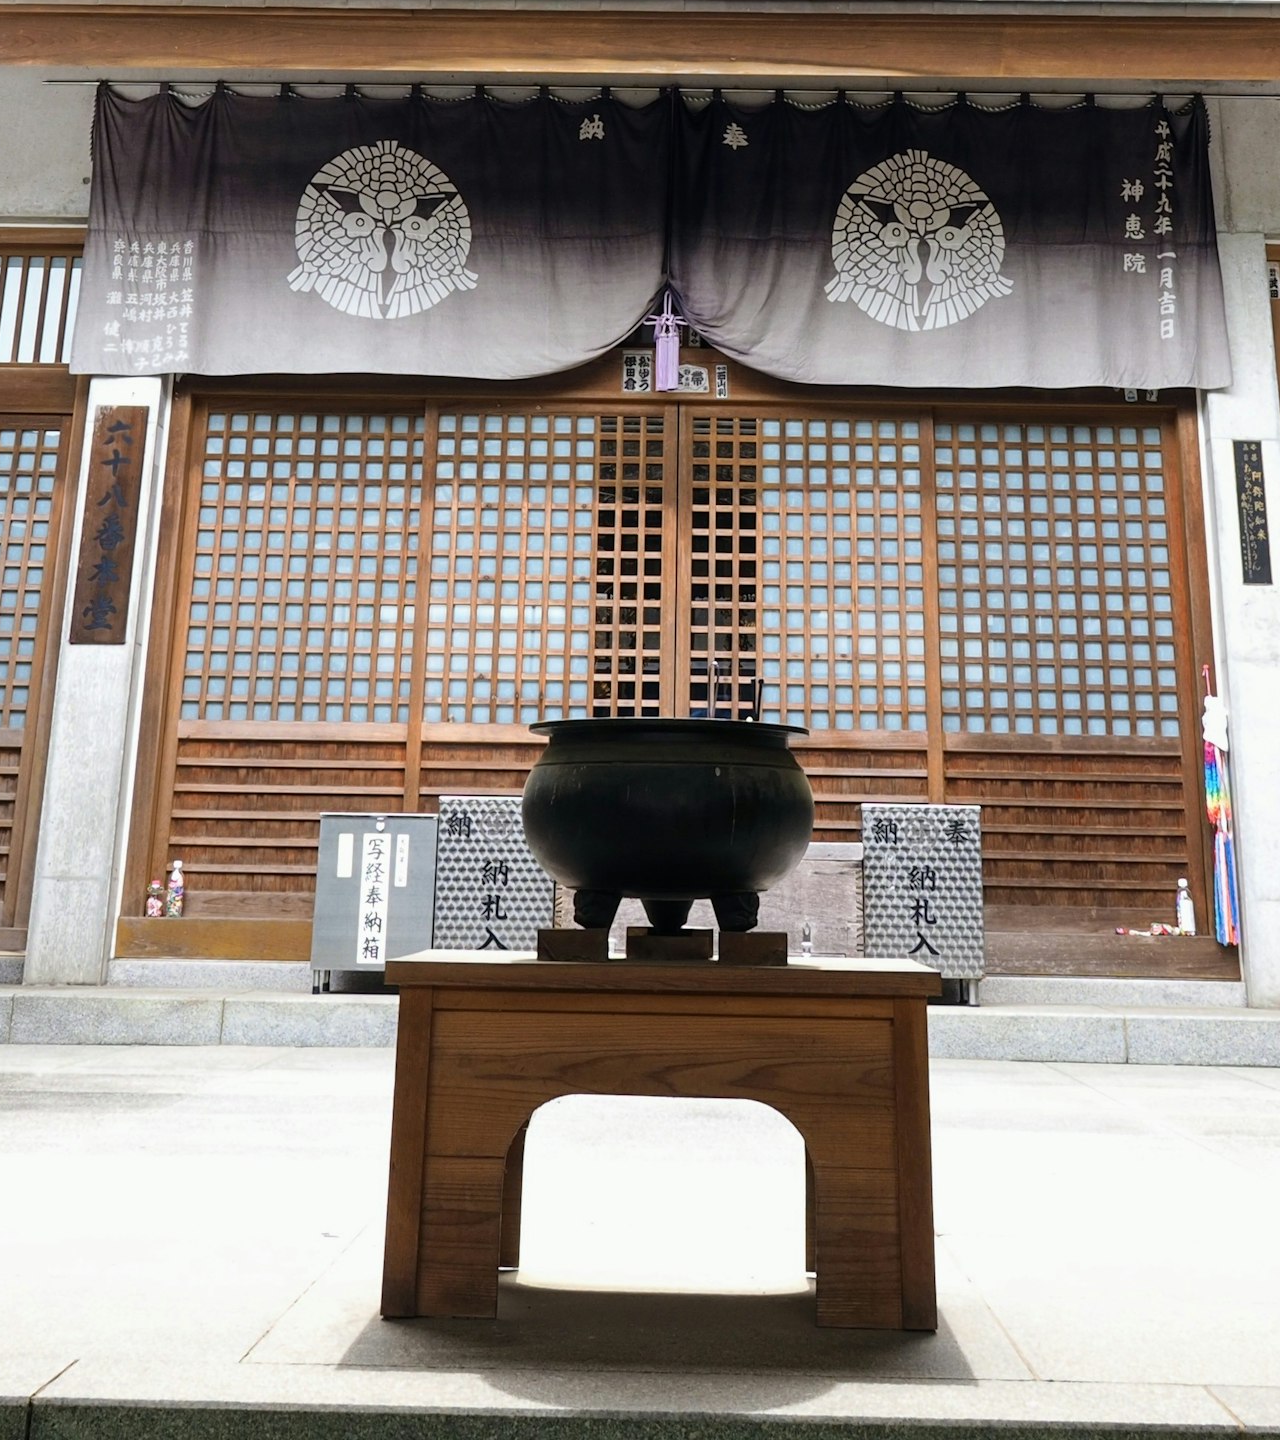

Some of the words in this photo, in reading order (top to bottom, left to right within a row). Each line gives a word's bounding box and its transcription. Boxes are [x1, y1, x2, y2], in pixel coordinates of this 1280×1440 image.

[579, 114, 605, 141] 納
[722, 122, 749, 150] 奉
[1120, 178, 1146, 273] 神恵院
[83, 420, 134, 630] 六十八番本堂
[1251, 470, 1268, 541] 阿弥陀如来
[447, 812, 471, 838] 納
[872, 818, 898, 846] 納
[945, 820, 969, 847] 奉
[362, 838, 385, 960] 写経奉納箱
[477, 860, 509, 950] 納札入
[908, 864, 940, 956] 納札入
